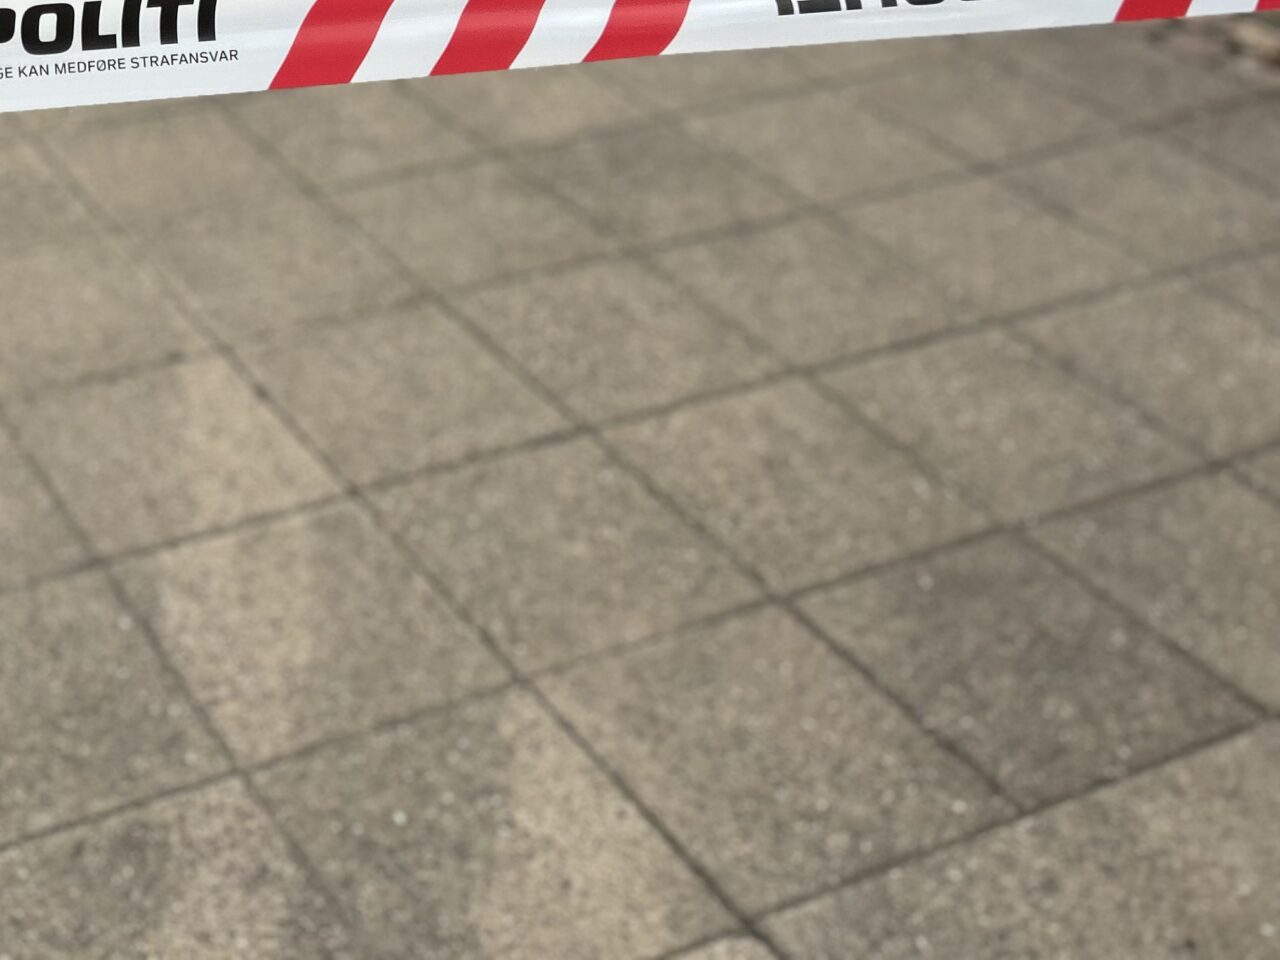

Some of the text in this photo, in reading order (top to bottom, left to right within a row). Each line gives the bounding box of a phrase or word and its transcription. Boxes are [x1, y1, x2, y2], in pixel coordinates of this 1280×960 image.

[17, 63, 50, 78] KAN
[54, 58, 127, 76] MEDFØRE
[130, 49, 239, 70] STRAFANSVAR
